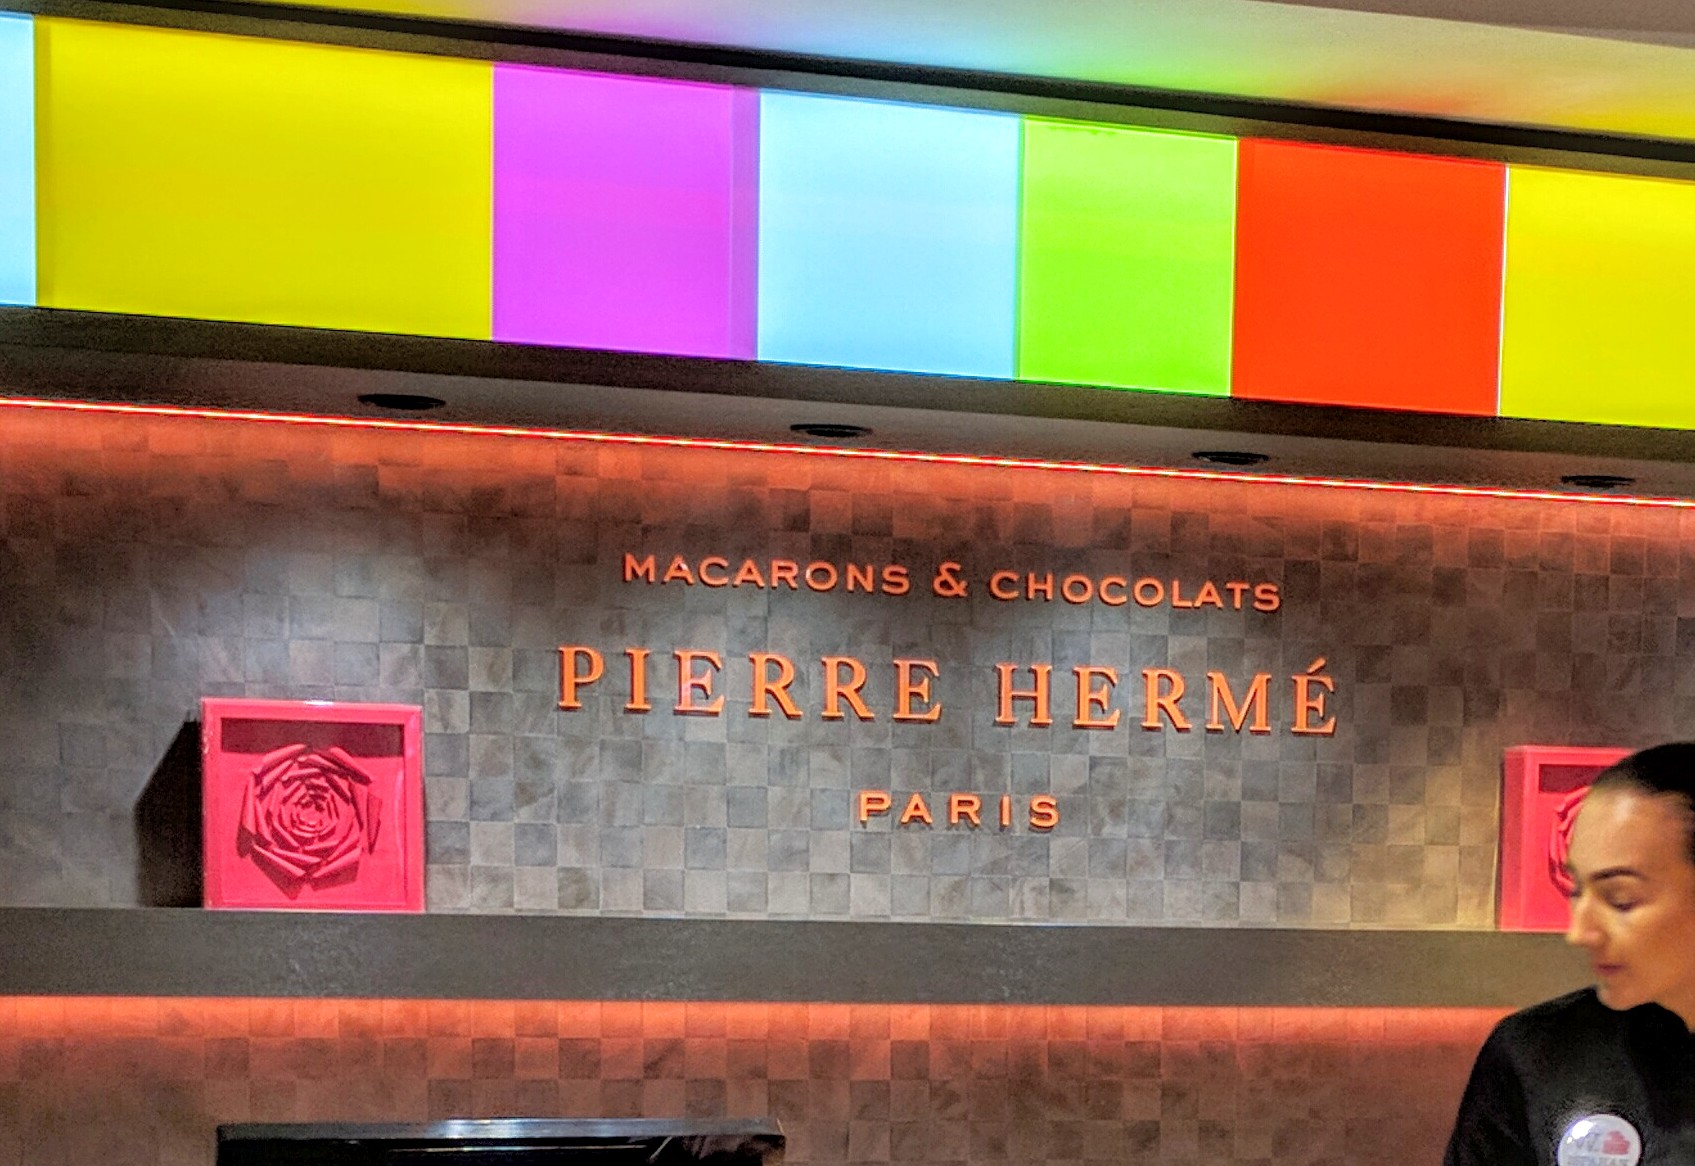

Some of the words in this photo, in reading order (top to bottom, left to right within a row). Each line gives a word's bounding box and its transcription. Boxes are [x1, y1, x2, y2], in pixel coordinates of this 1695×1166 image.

[624, 554, 910, 596] MACARONS
[932, 562, 968, 598] &
[990, 571, 1282, 612] CHOCOLATS
[559, 645, 942, 721] PIERRE
[996, 658, 1337, 735] HERMÉ
[859, 791, 1060, 828] PARIS
